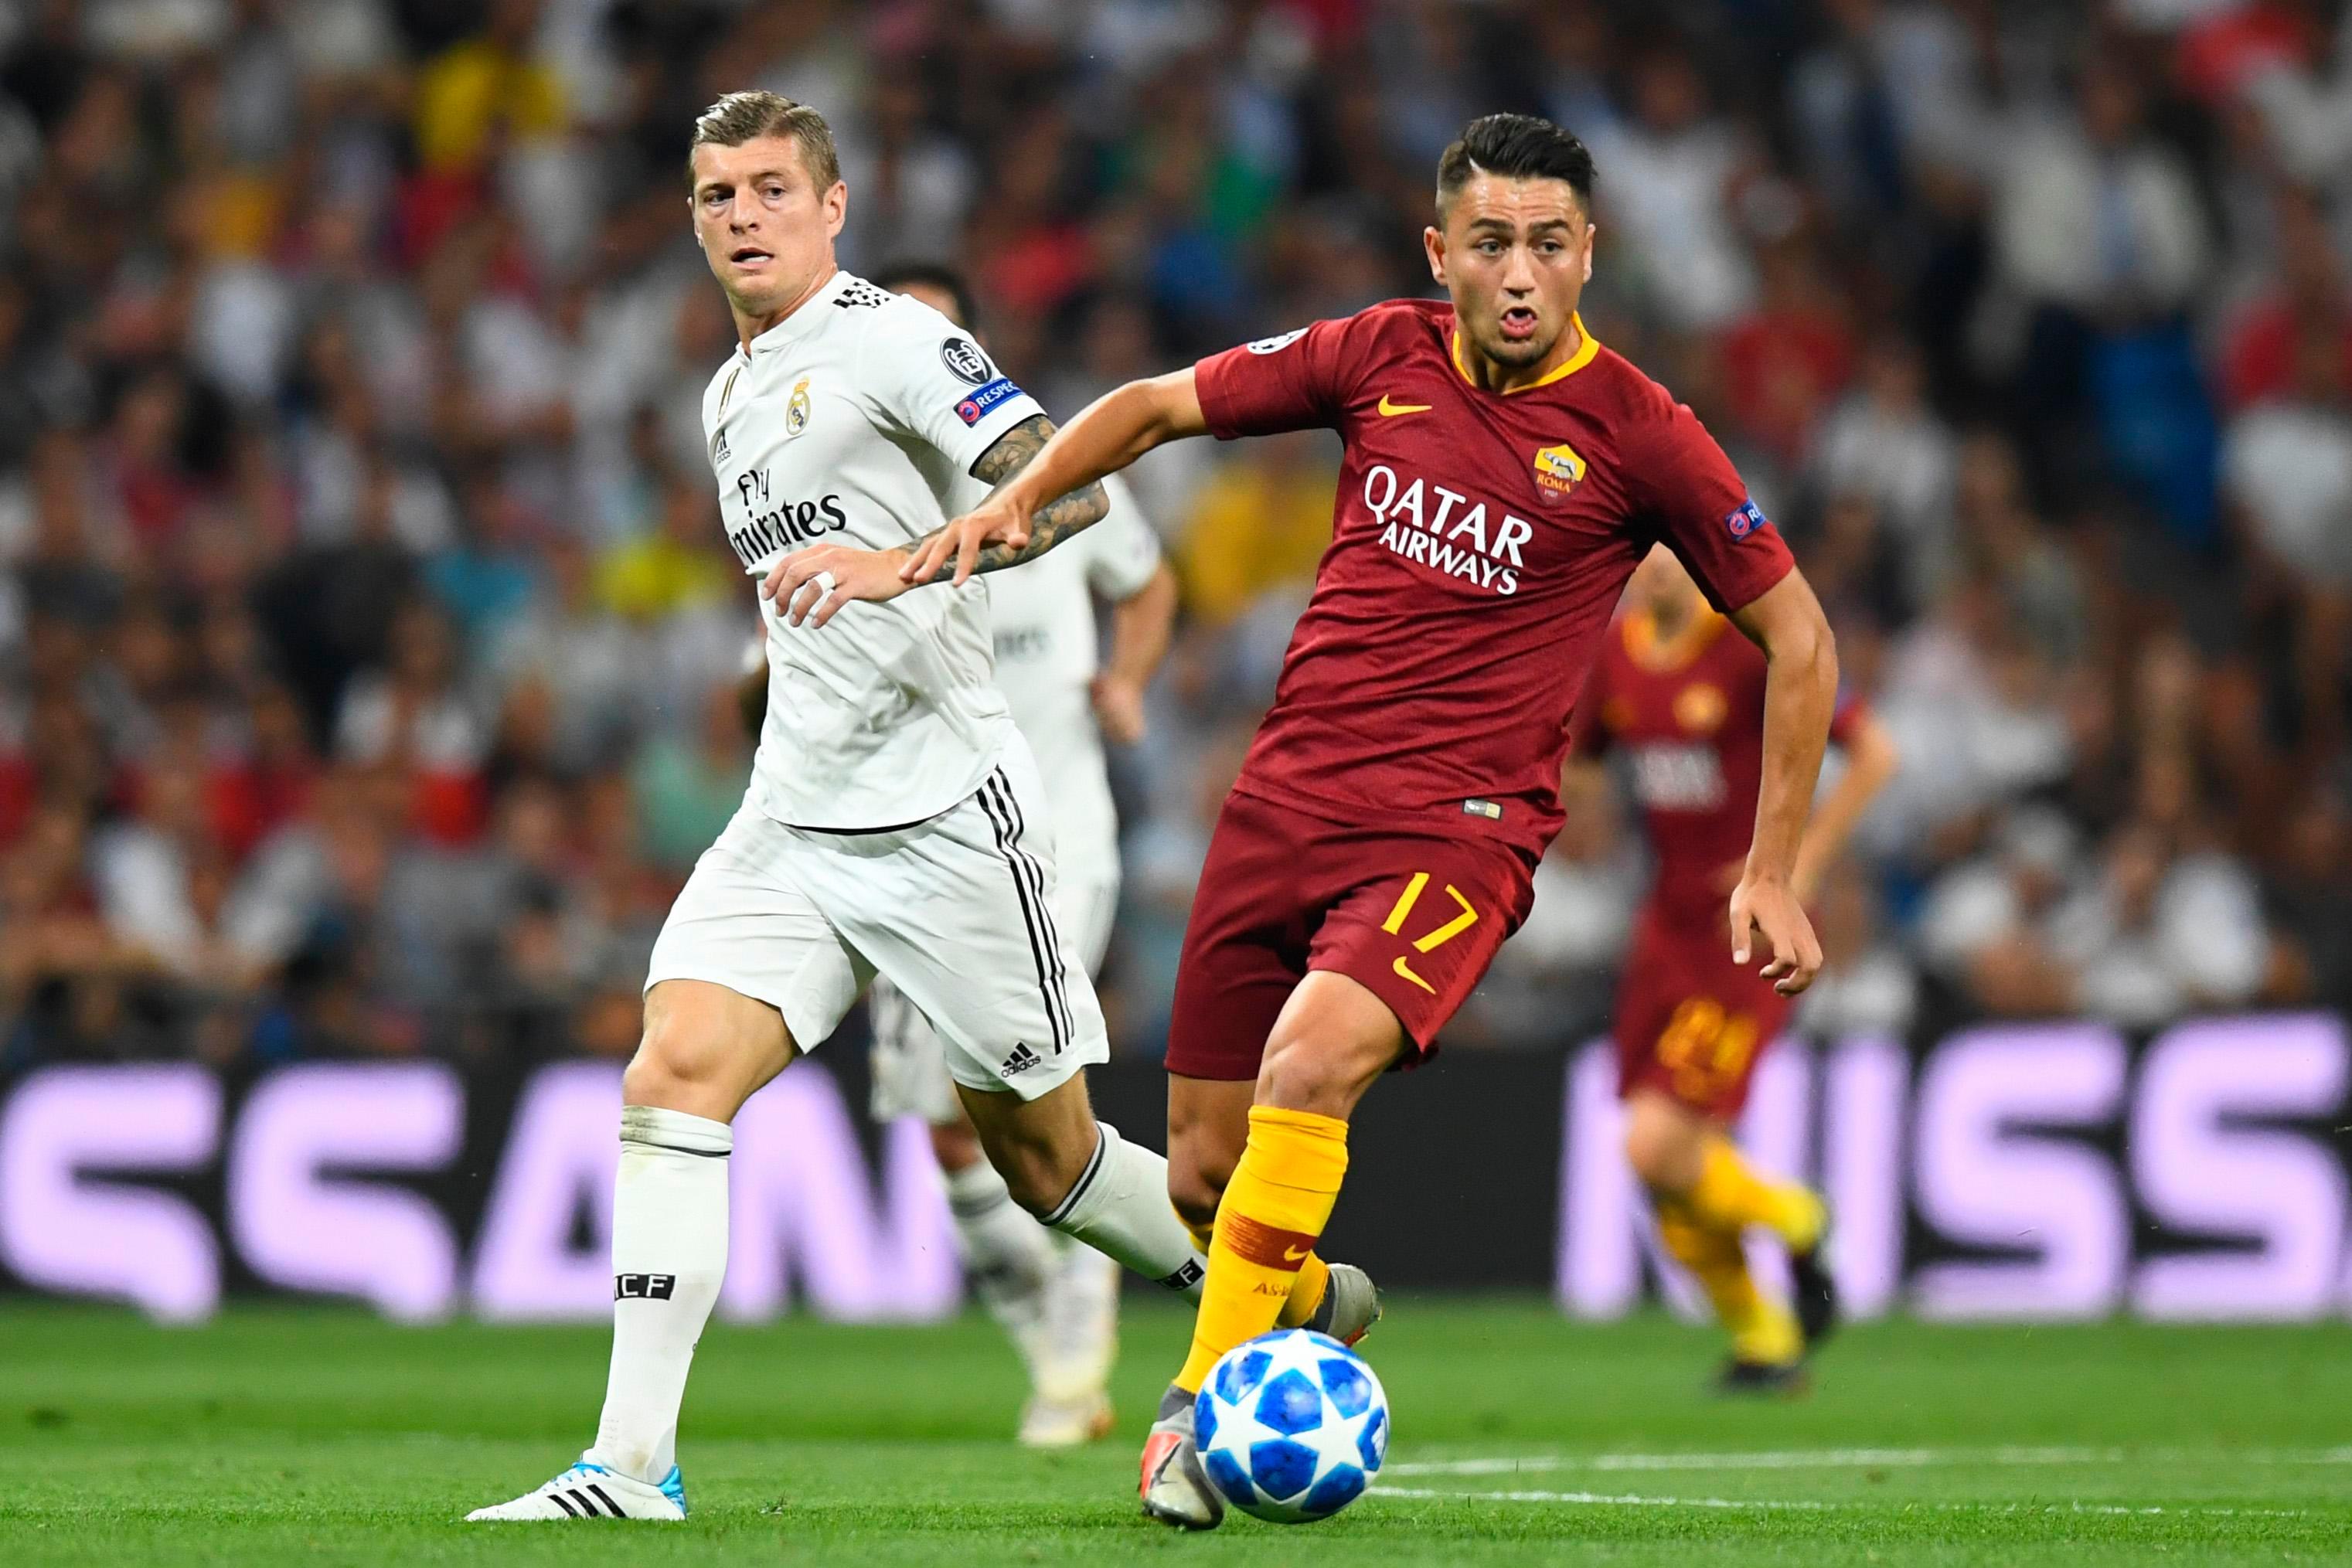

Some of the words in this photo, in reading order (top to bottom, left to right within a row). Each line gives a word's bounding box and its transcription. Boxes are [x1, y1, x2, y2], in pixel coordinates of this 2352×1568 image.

[960, 358, 983, 376] 13
[975, 381, 1020, 408] RESPEC
[737, 468, 770, 507] Fly
[1537, 473, 1571, 494] ROMA
[731, 494, 846, 565] mirates
[1364, 465, 1533, 569] QATAR
[1378, 520, 1520, 595] AIRWAYS
[1380, 872, 1479, 954] 17
[1001, 1054, 1041, 1078] adidas
[1557, 1012, 2352, 1325] NISS
[614, 1275, 668, 1298] CF
